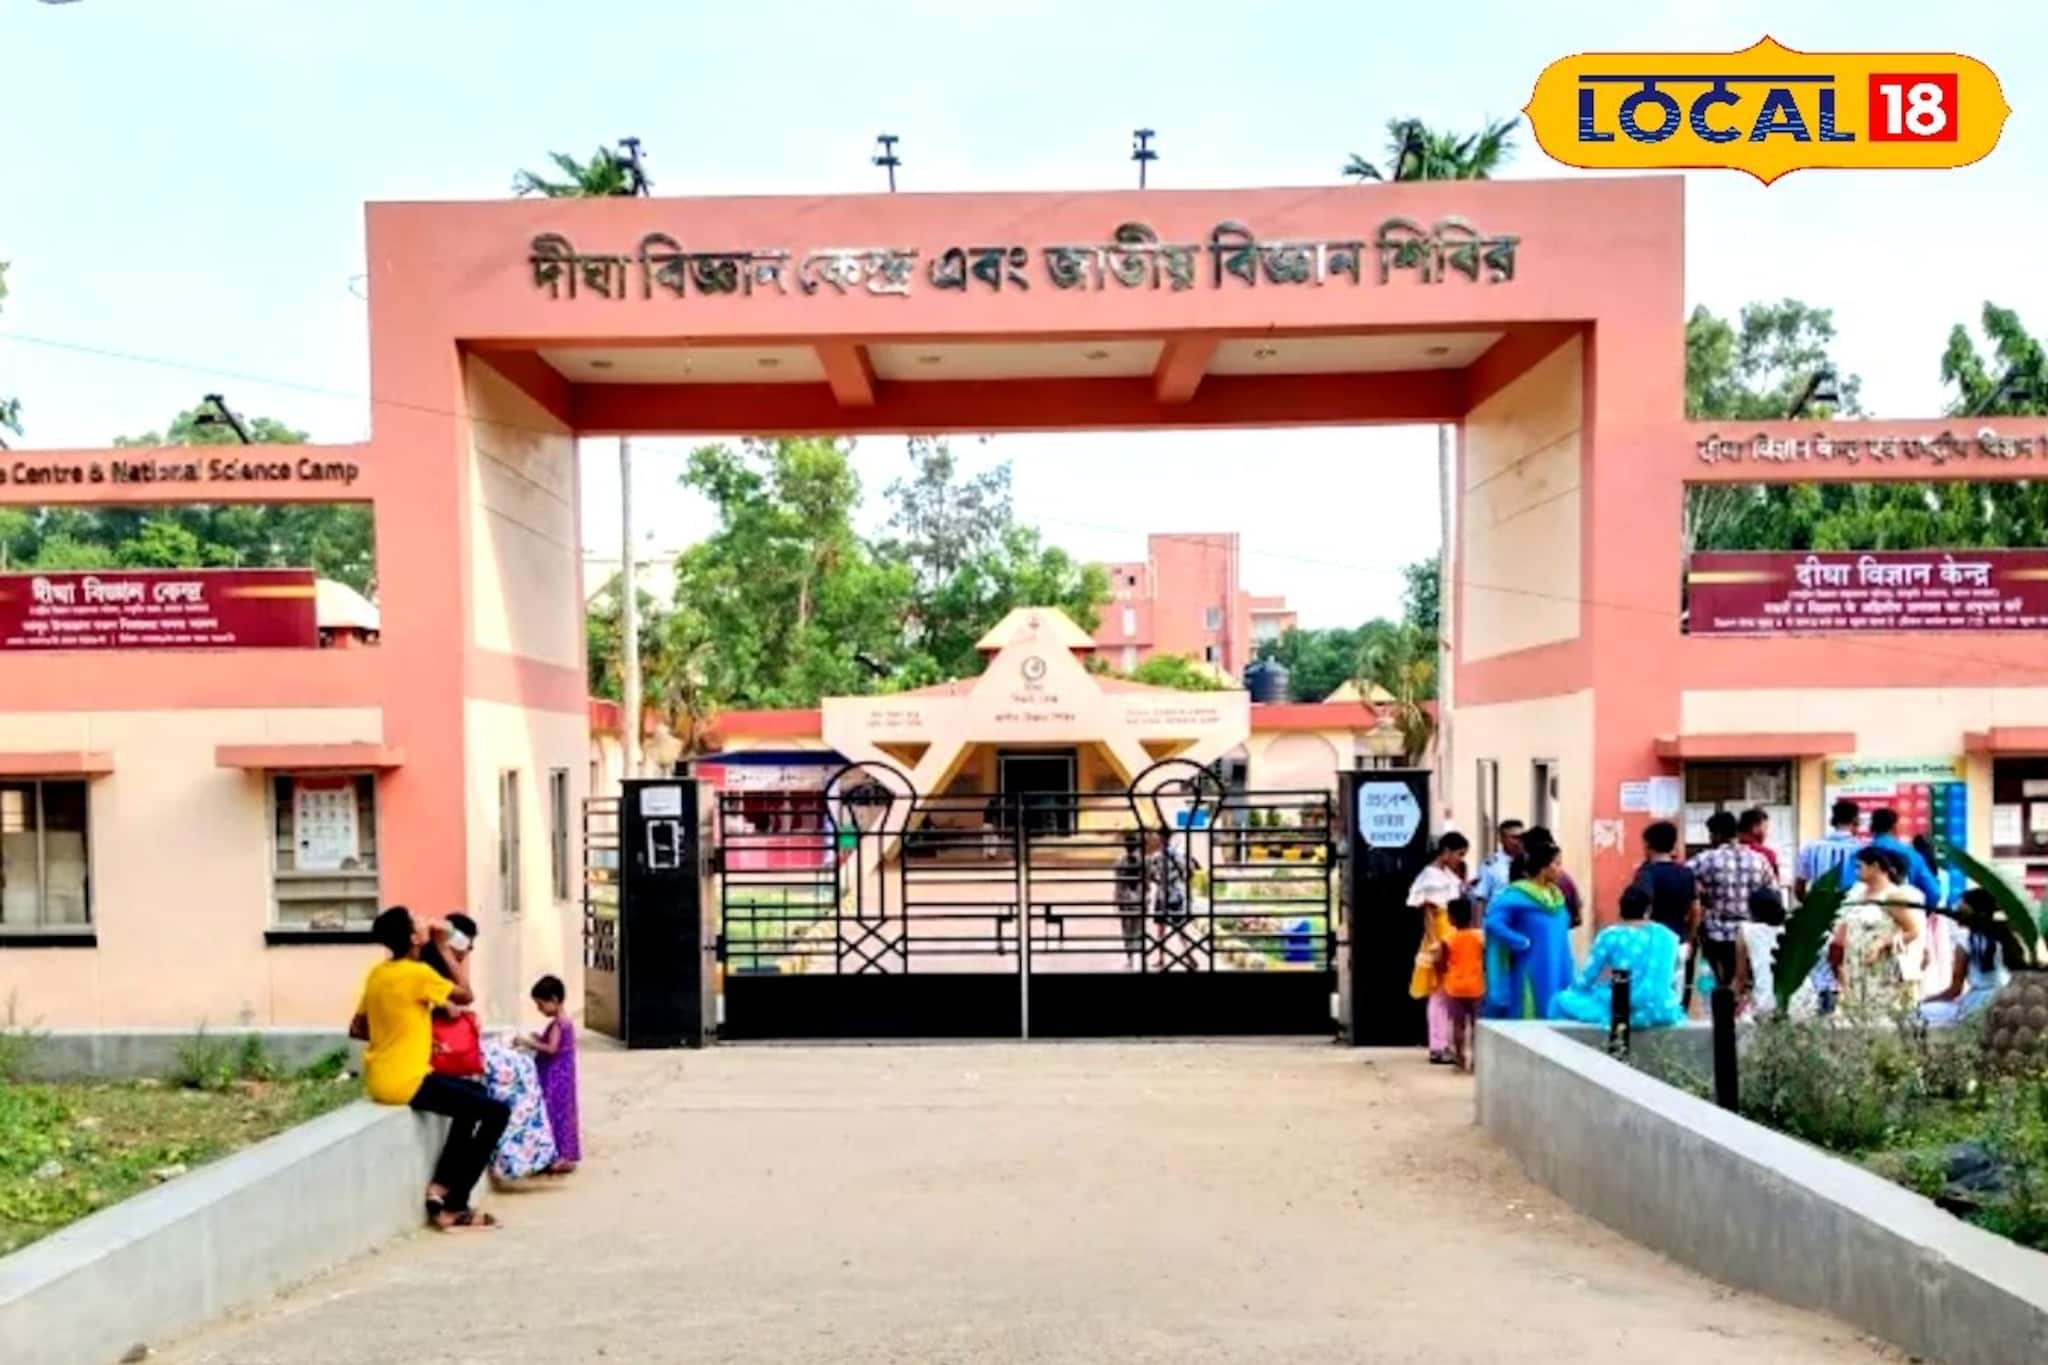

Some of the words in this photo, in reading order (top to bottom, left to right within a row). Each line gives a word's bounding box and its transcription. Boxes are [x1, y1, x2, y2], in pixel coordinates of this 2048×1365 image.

[530, 233, 627, 300] দীঘা
[640, 233, 791, 298] বিজ্ঞান
[800, 247, 918, 297] কেন্দ্র
[928, 245, 1030, 291] এবং
[1209, 221, 1364, 288] বিজ্ঞান
[1376, 216, 1520, 287] শিবির
[12, 462, 83, 485] Centre
[111, 460, 199, 484] National
[209, 458, 291, 482] Science
[297, 457, 360, 486] Camp
[1796, 556, 1850, 587] दीघा
[1858, 556, 1933, 586] विज्ञान
[1939, 554, 1992, 587] केन्द्र
